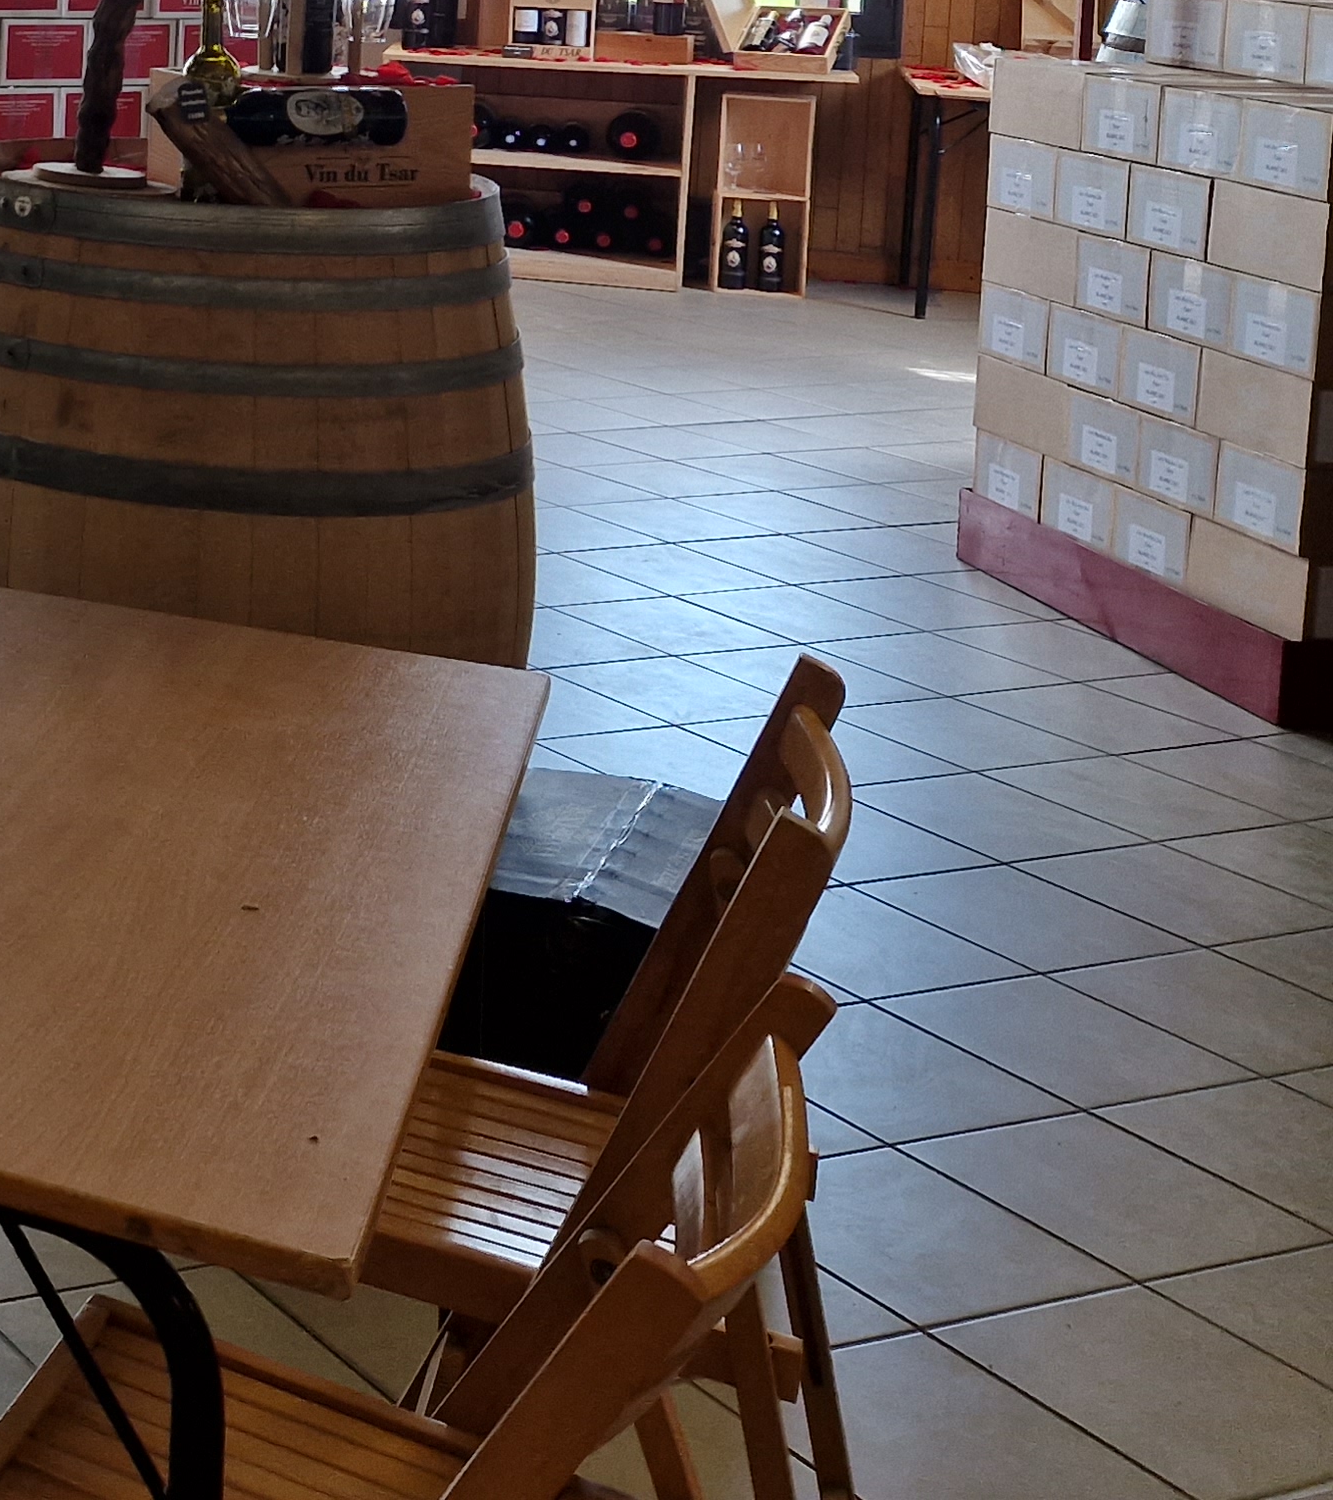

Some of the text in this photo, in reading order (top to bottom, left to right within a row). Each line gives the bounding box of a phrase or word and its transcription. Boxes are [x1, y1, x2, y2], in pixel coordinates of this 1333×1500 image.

[304, 162, 420, 183] Vin du Tsar
